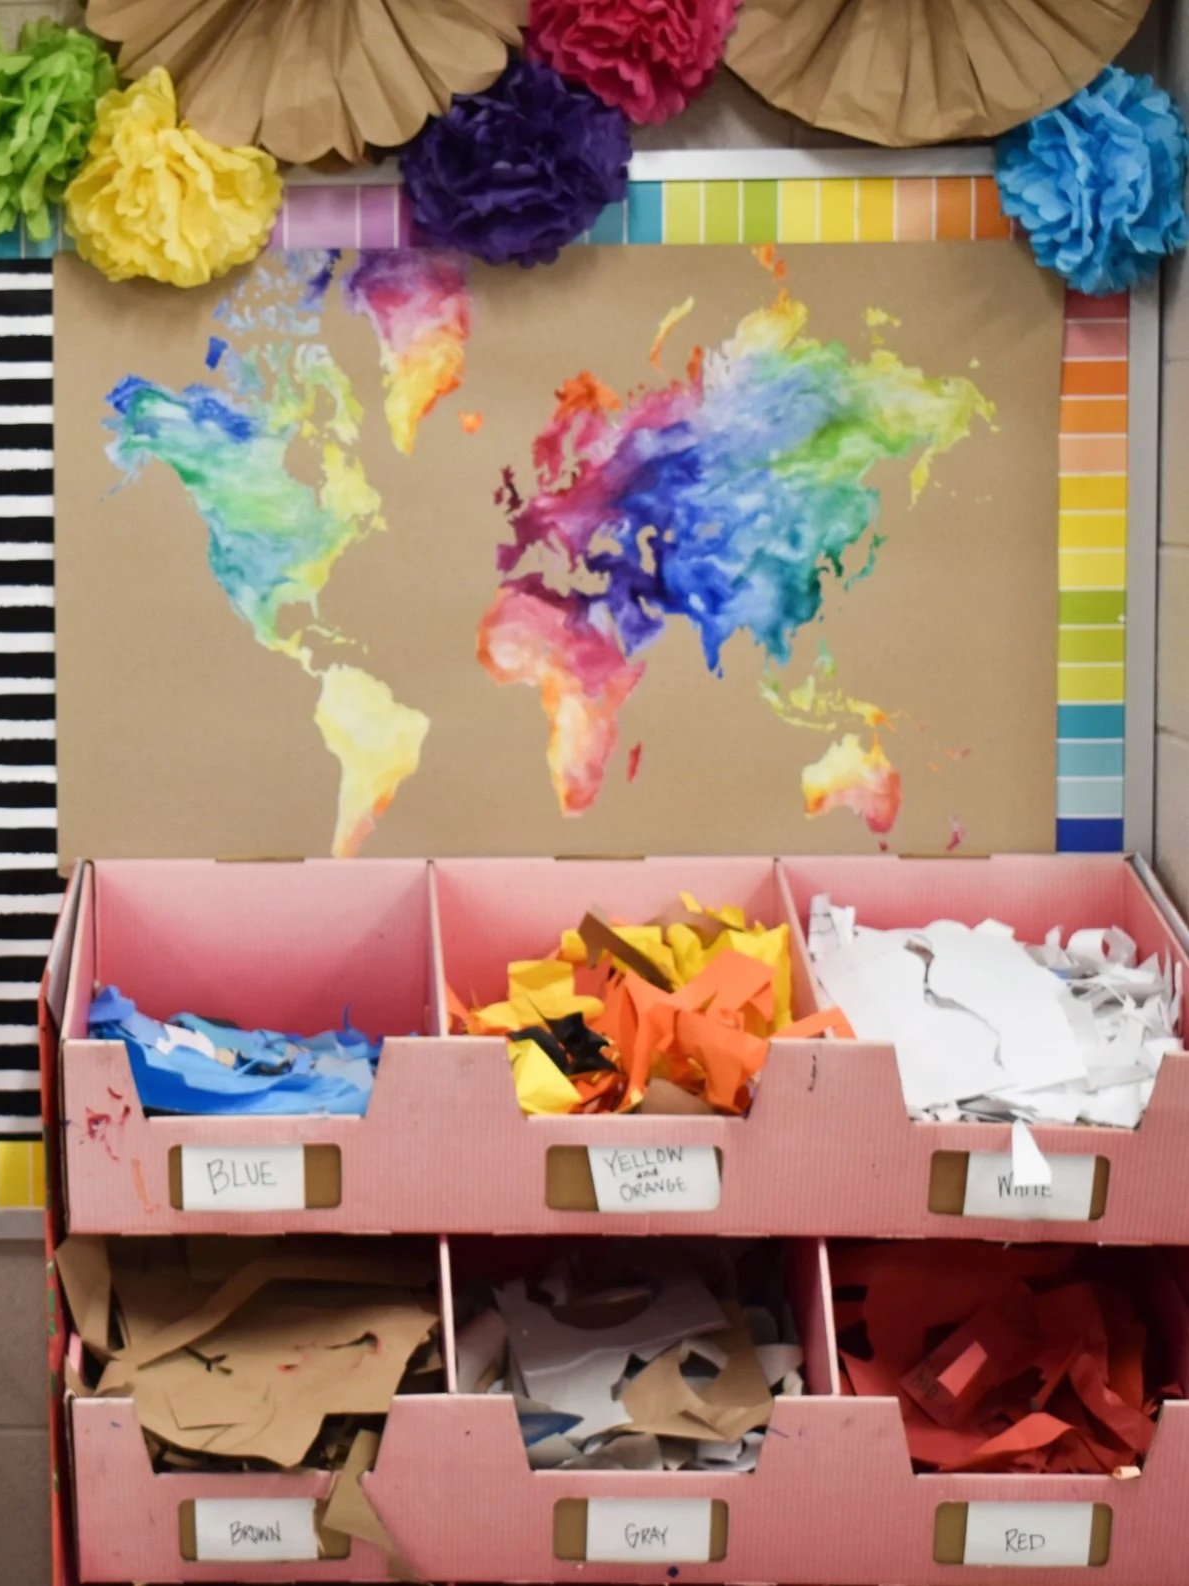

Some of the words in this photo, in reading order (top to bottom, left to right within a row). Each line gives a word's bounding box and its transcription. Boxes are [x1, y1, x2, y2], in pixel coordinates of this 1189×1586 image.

[603, 1145, 684, 1177] YELLOW
[636, 1166, 659, 1179] and
[207, 1158, 278, 1195] BLUE
[619, 1177, 687, 1202] ORANGE
[229, 1520, 281, 1546] BROWN
[624, 1523, 669, 1548] GRAY
[1005, 1528, 1046, 1552] RED
